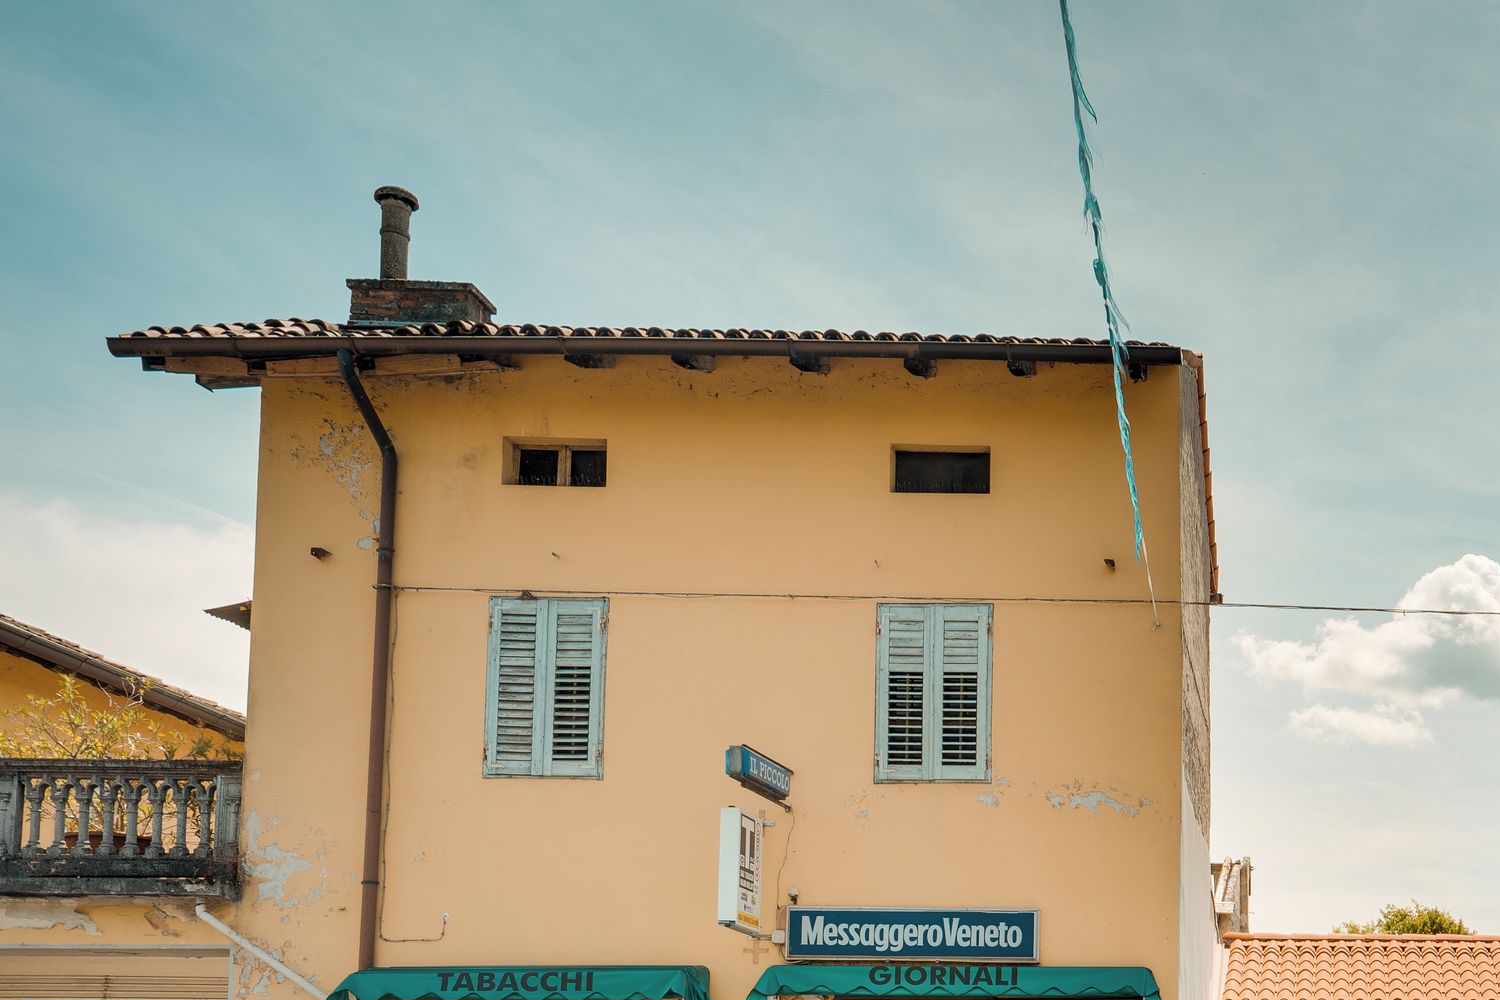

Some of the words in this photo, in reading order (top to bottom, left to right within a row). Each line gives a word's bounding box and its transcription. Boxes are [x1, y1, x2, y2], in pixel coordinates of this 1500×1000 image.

[750, 756, 758, 775] IL
[759, 761, 790, 792] PICCOLO
[800, 915, 1023, 952] MessaggeroVeneto
[437, 971, 594, 992] TABACCHI
[868, 965, 1018, 986] GIORNALI
